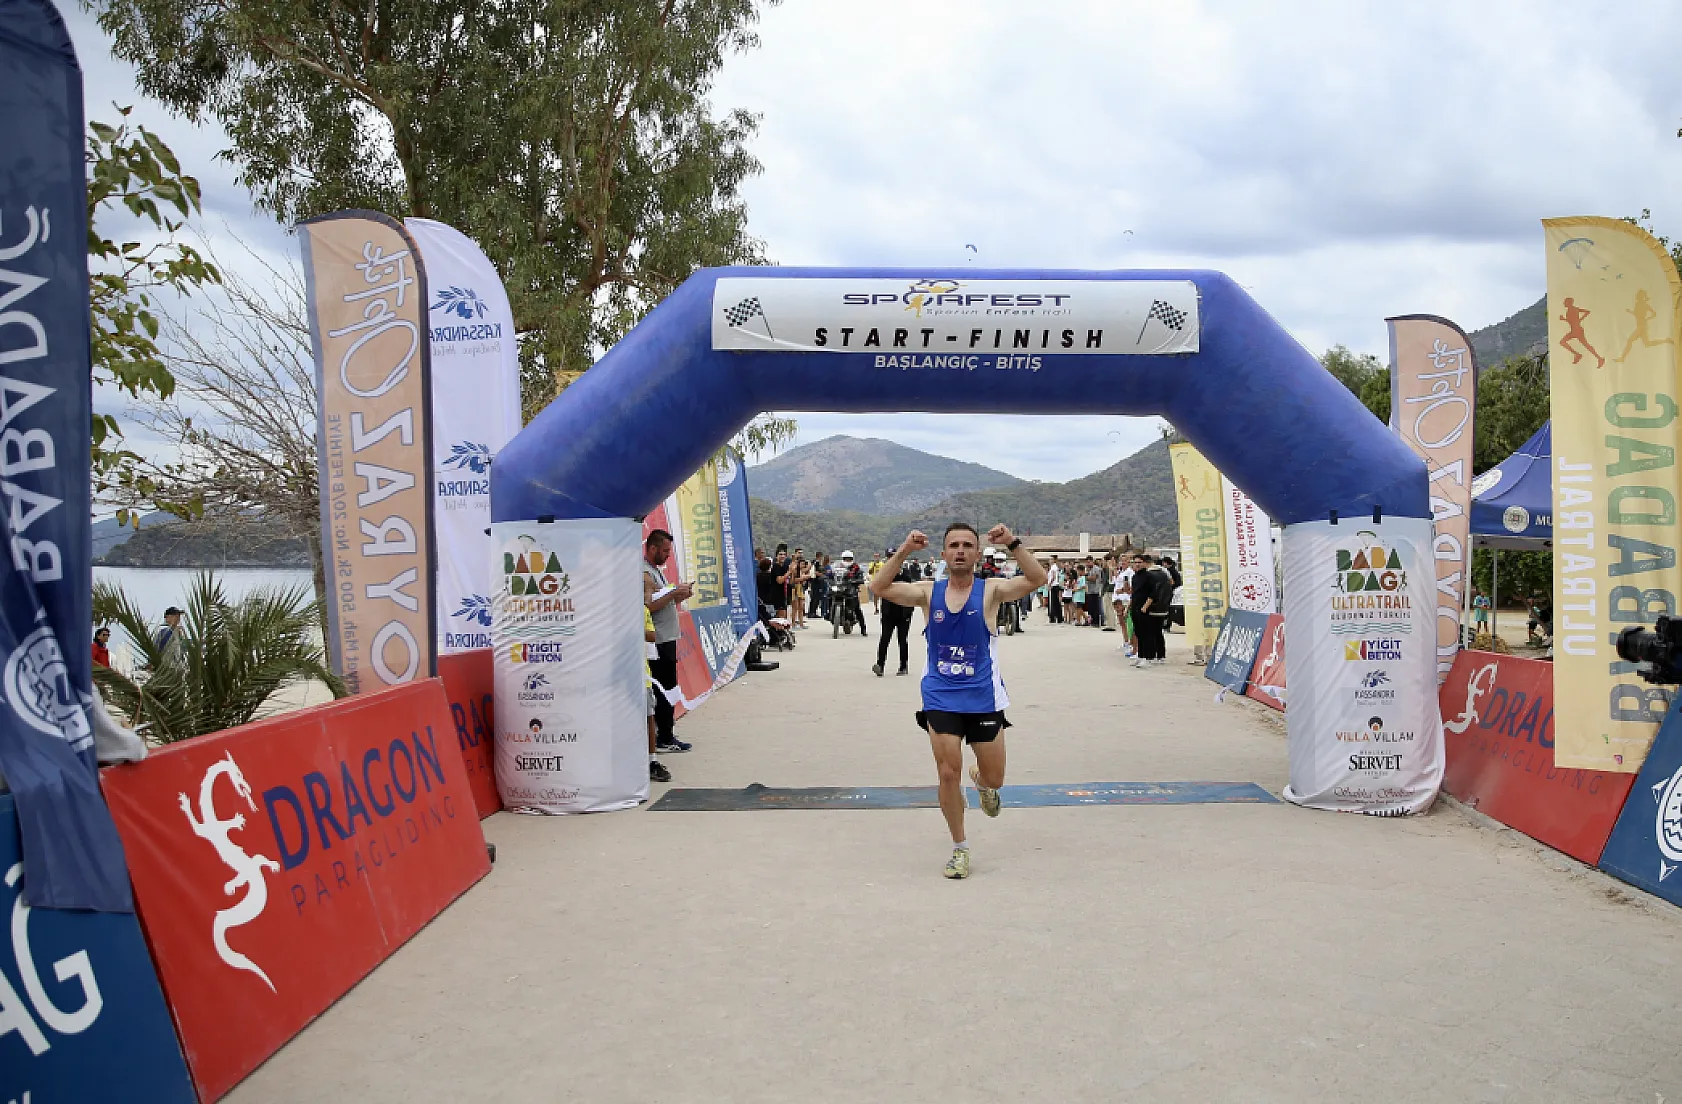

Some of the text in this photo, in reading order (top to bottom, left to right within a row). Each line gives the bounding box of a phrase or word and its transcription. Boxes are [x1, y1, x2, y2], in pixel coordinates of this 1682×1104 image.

[874, 354, 978, 371] BAŞLANGIÇ
[996, 353, 1042, 371] BİTİŞ
[1332, 595, 1412, 610] ULTRATRAIL
[949, 646, 964, 658] 74
[515, 754, 563, 772] SERVET
[1349, 754, 1403, 772] SERVET
[262, 725, 446, 873] DRAGON
[291, 796, 456, 918] PARAGLIDING
